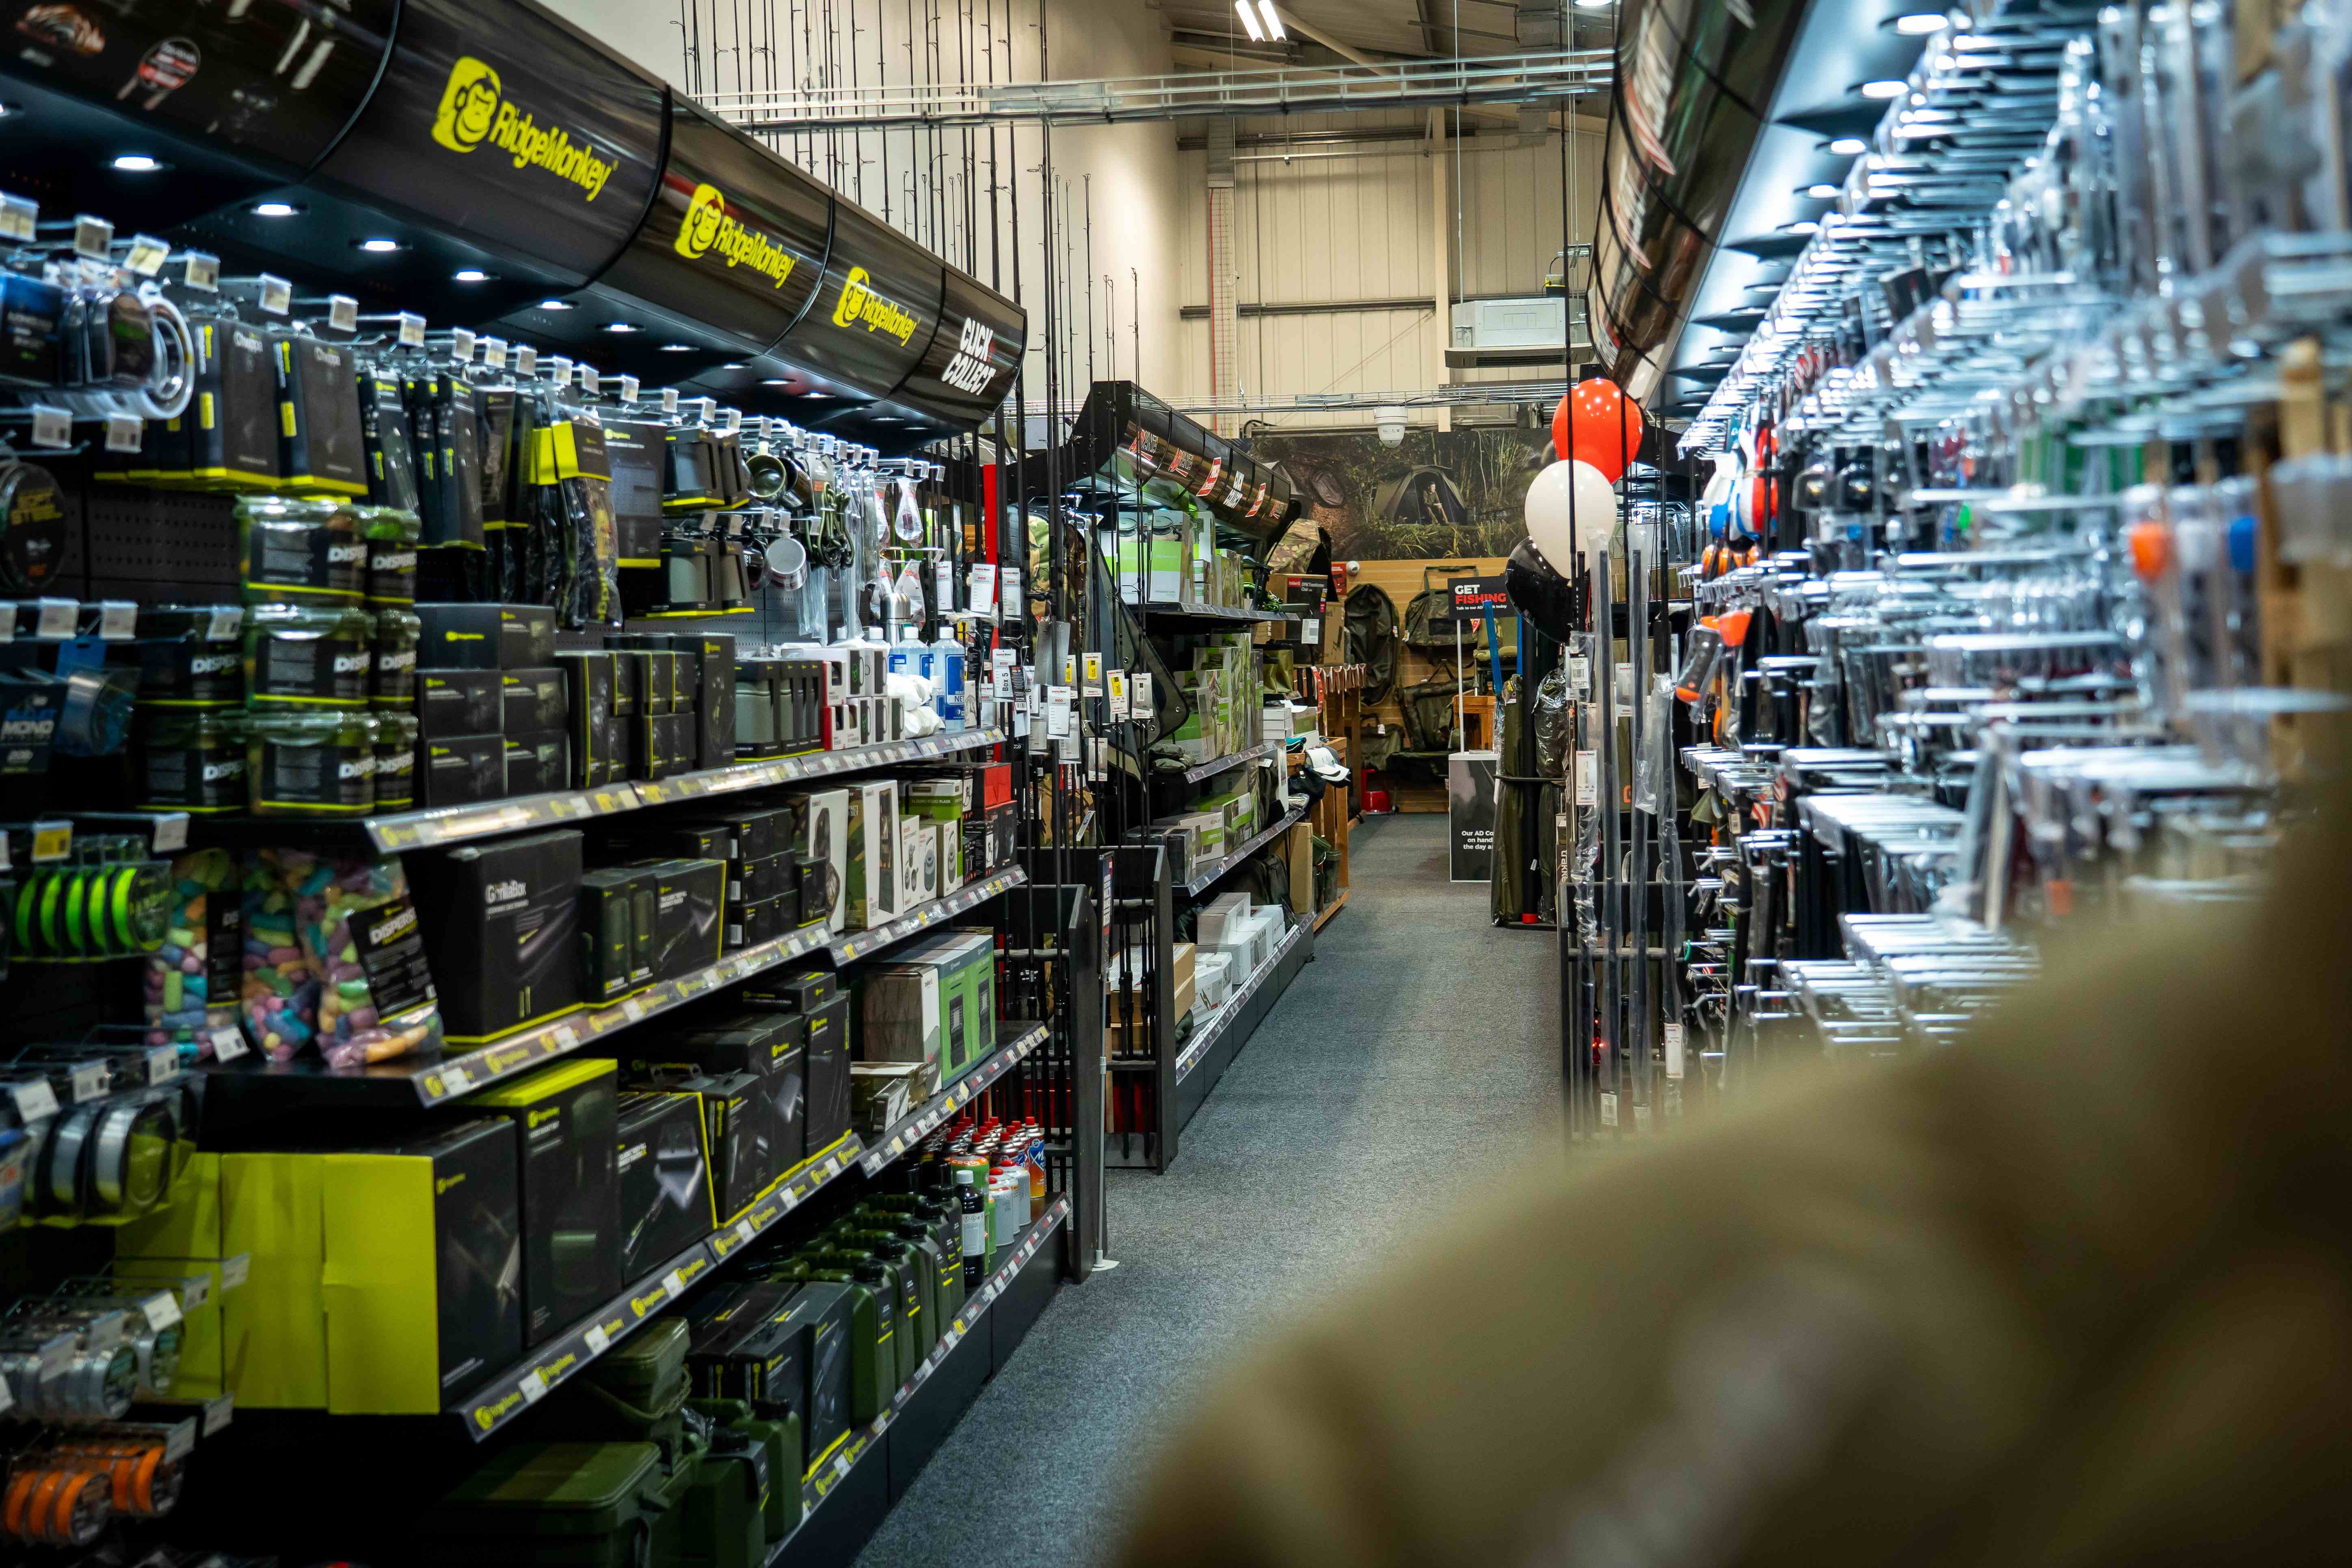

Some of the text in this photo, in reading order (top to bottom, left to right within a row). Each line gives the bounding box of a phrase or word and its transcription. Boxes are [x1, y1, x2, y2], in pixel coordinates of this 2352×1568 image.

[489, 100, 612, 201] RidgeMonkey
[711, 214, 795, 289] RidgeMonkey
[861, 291, 918, 346] RidgeMonkey
[960, 317, 994, 361] CLICK
[941, 353, 996, 396] COLLECT
[1455, 584, 1480, 595] GET
[1455, 593, 1506, 605] FISHING
